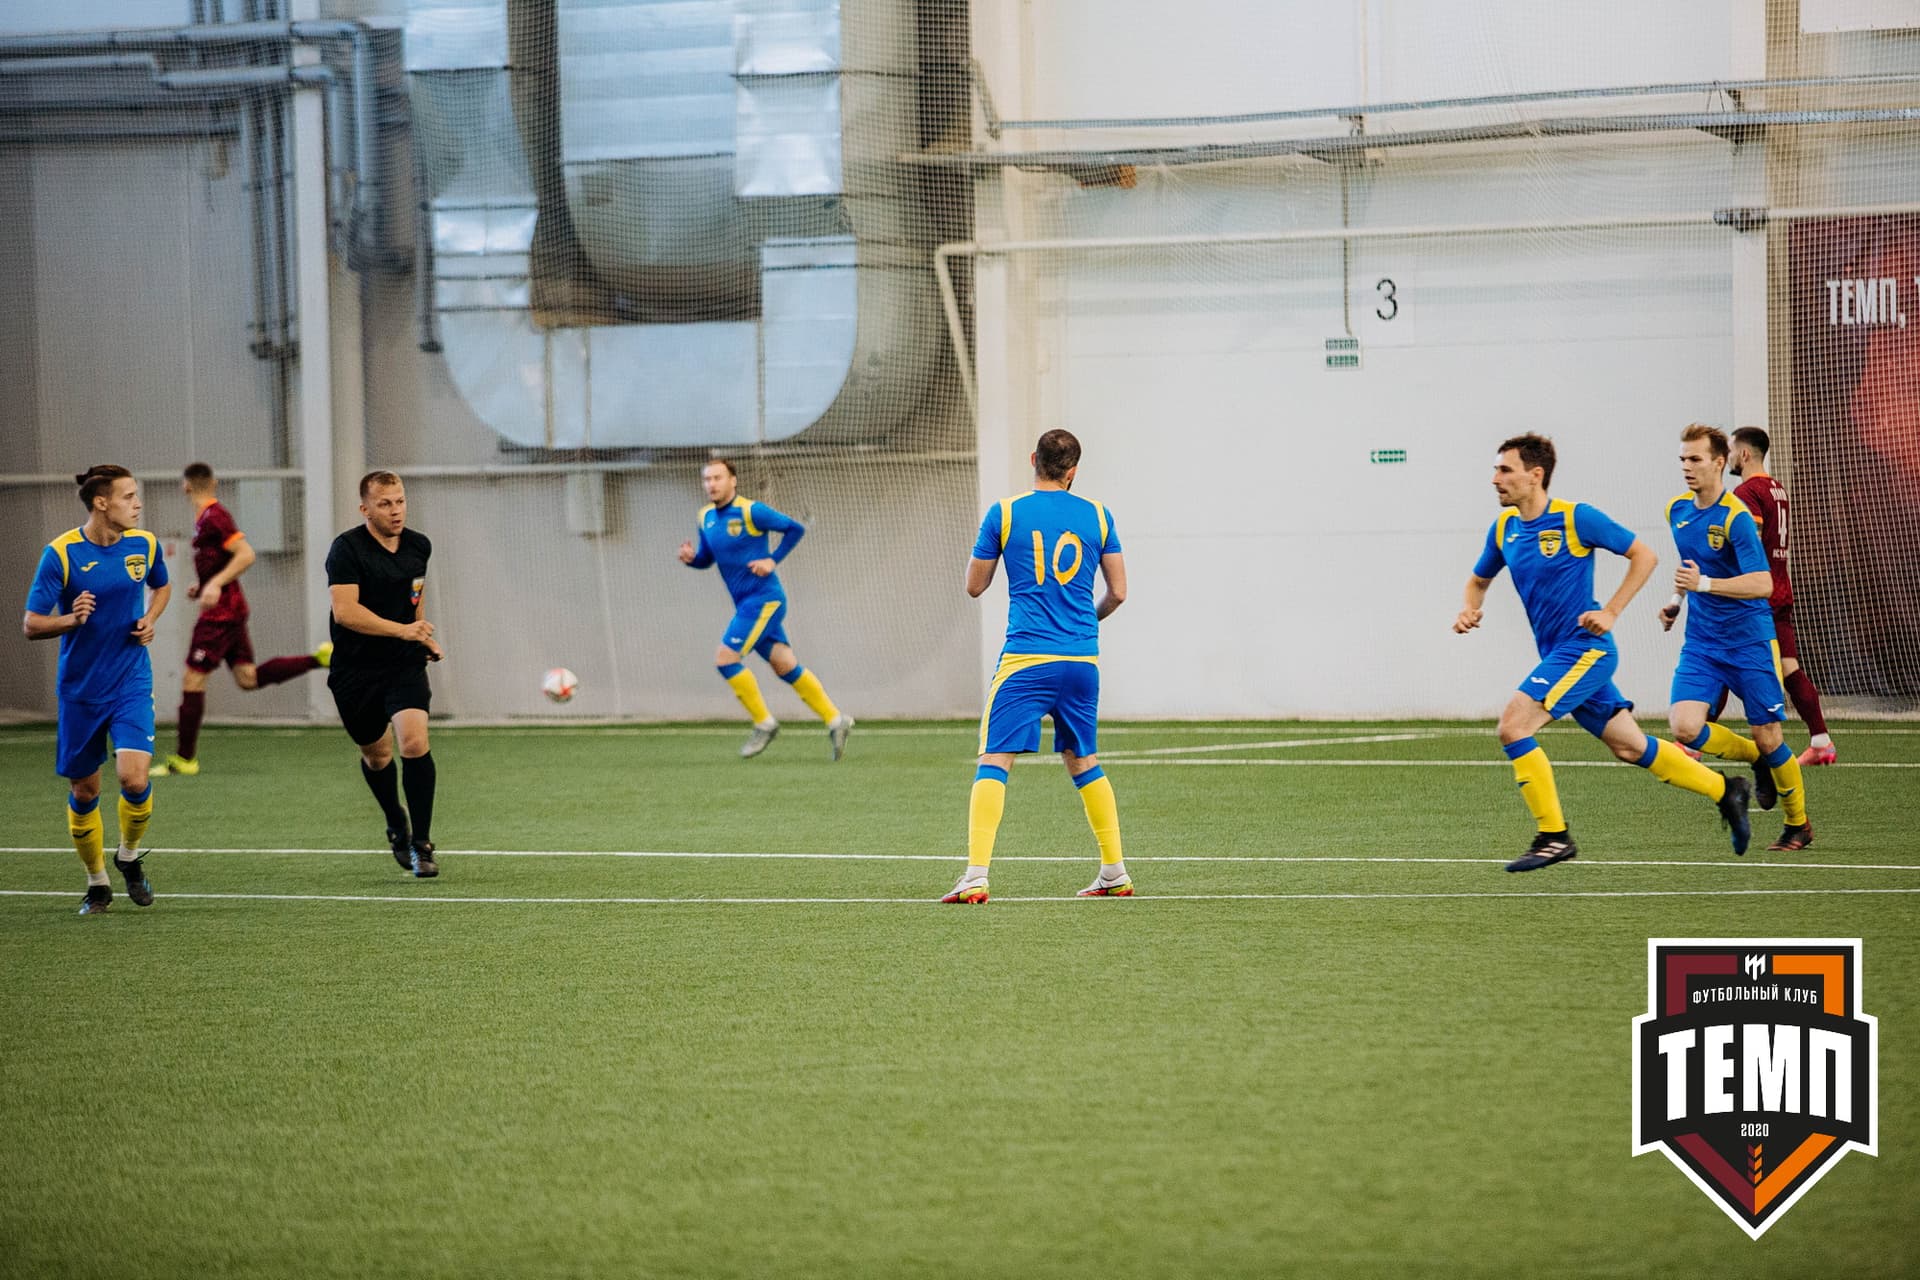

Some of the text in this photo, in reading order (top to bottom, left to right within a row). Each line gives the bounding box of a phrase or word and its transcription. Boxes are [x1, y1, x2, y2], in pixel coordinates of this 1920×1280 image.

[1376, 278, 1398, 320] 3
[1826, 276, 1906, 329] ТЕМП,
[1777, 500, 1787, 548] 4
[1031, 529, 1083, 586] 10
